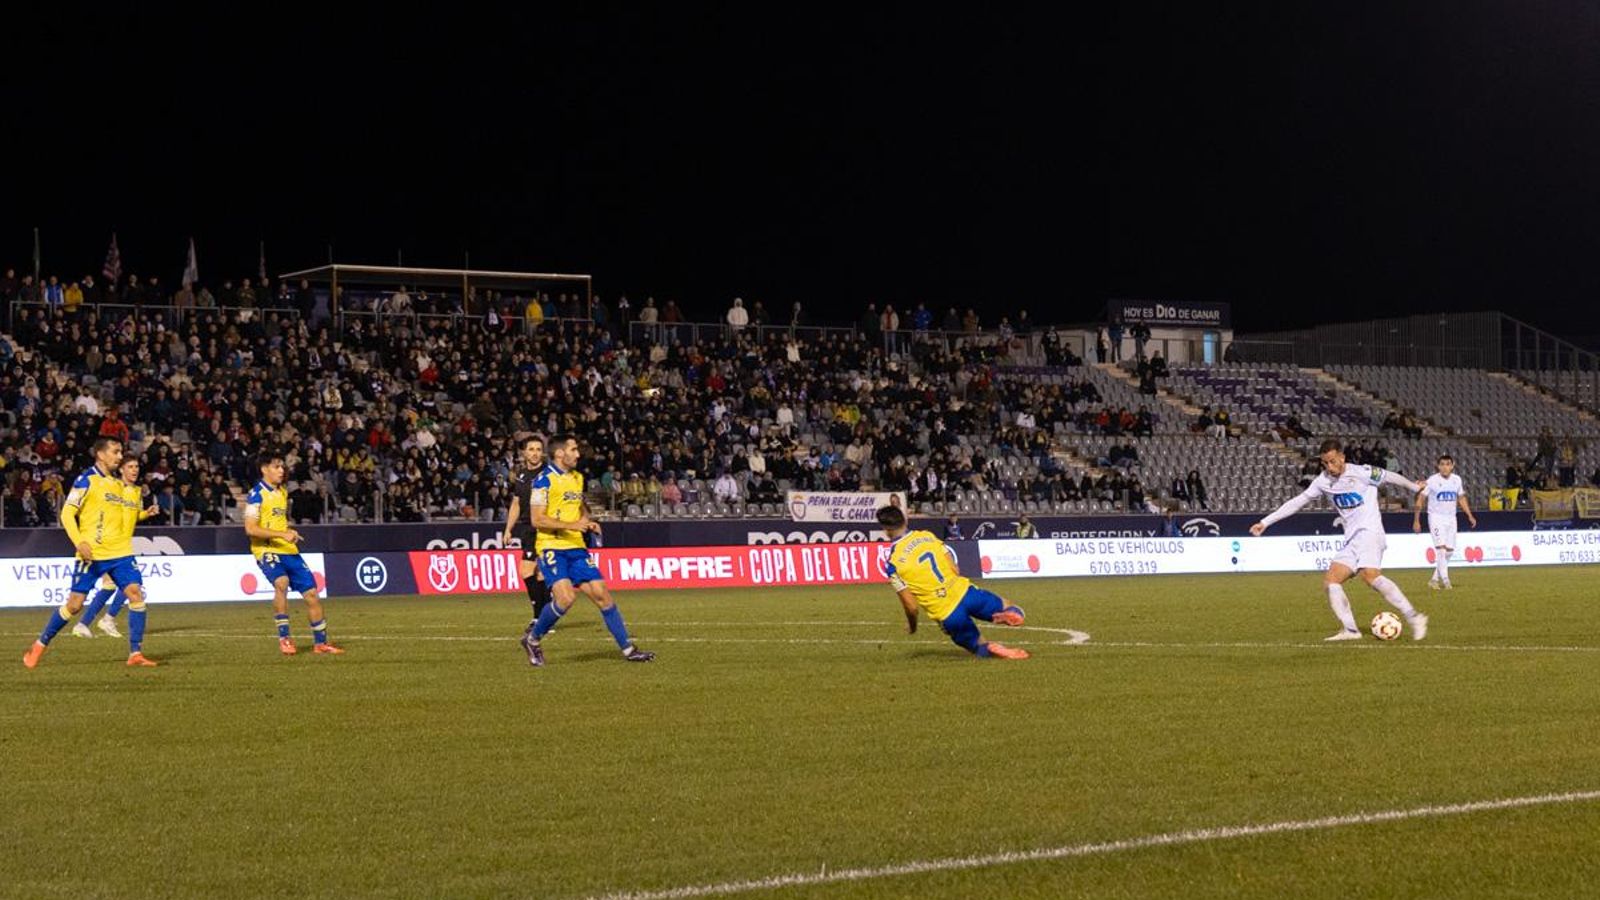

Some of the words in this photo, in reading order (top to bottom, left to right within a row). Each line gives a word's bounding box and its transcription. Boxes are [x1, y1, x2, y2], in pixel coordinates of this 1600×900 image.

[1124, 307, 1141, 318] HOY
[1143, 308, 1154, 318] ES
[1178, 310, 1190, 319] DE
[1191, 310, 1220, 320] GANAR
[831, 497, 851, 506] REAL
[848, 508, 877, 520] CHAT
[1297, 540, 1333, 552] VENTA
[1533, 533, 1564, 546] BAJAS
[1566, 533, 1579, 545] DE
[1056, 541, 1096, 555] BAJAS
[1099, 541, 1115, 554] DE
[1559, 550, 1576, 562] 670
[363, 565, 380, 574] RF
[620, 556, 733, 581] MAPFRE
[749, 548, 797, 583] COPA
[802, 547, 834, 581] DEL
[838, 546, 869, 580] REY
[918, 551, 944, 583] 7
[1090, 561, 1111, 574] 670
[1114, 561, 1134, 573] 633
[1137, 560, 1158, 573] 319
[12, 563, 73, 580] VENTA
[466, 554, 520, 591] COPA
[363, 576, 380, 584] EF
